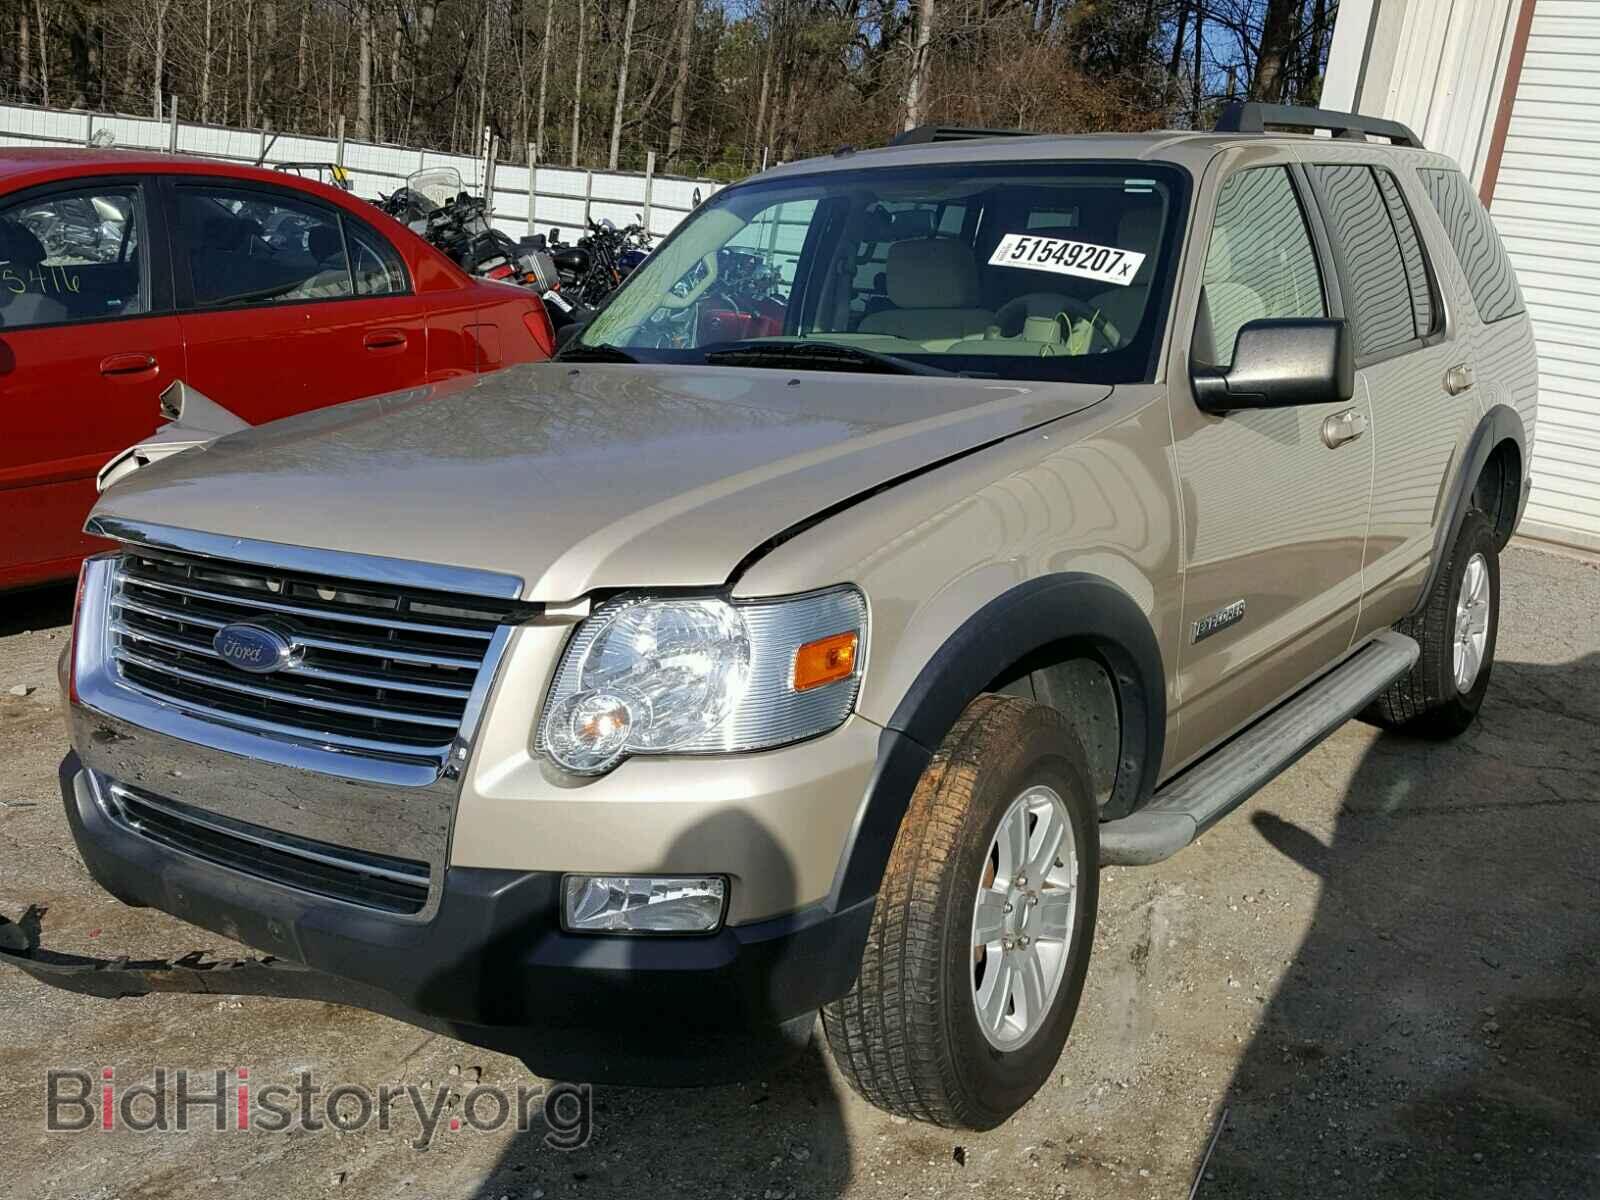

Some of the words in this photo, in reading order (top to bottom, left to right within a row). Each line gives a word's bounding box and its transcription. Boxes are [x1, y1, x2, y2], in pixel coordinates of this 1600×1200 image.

[1010, 237, 1125, 274] 51549207
[2, 264, 80, 295] 5416
[223, 637, 264, 662] Ford
